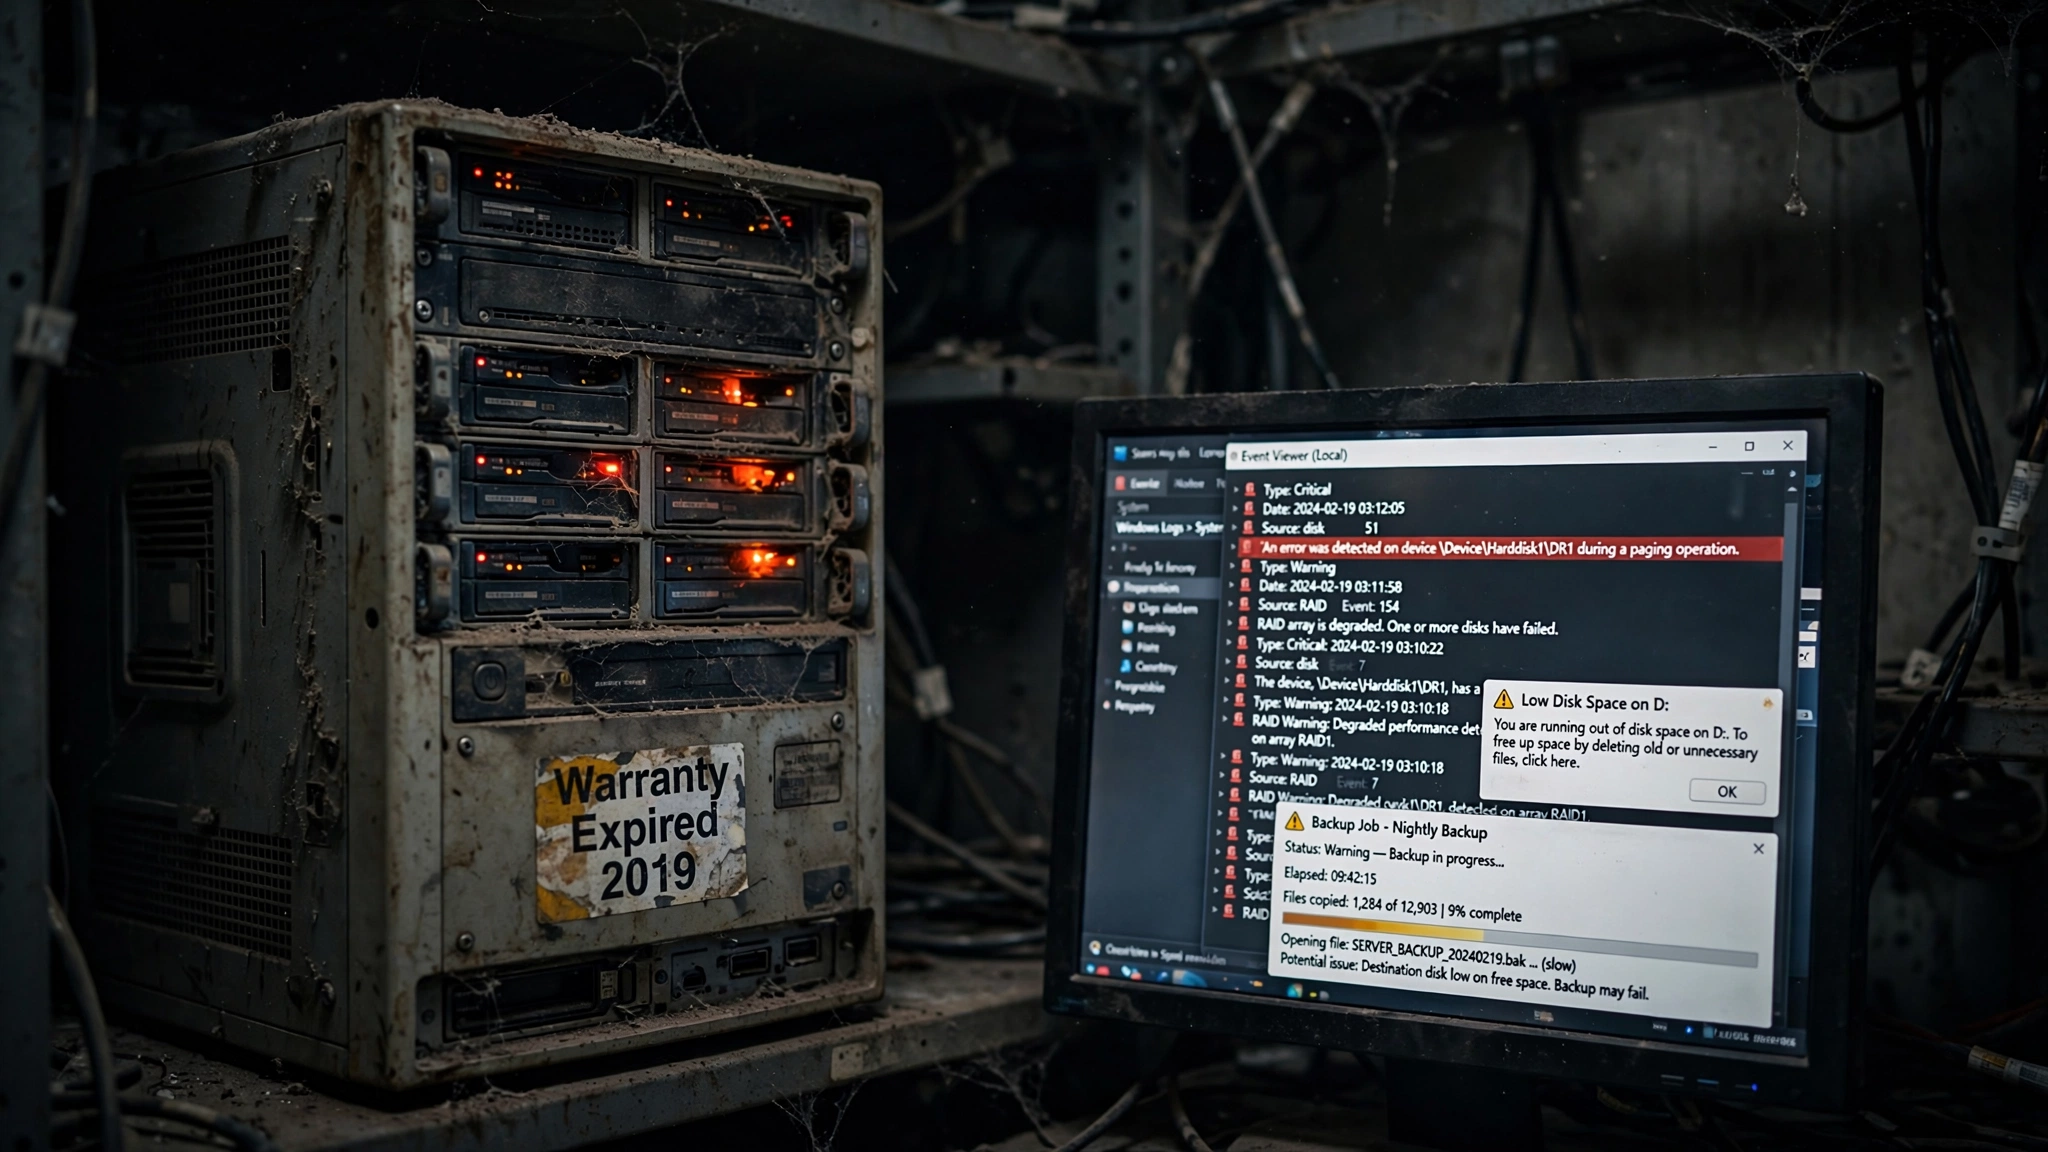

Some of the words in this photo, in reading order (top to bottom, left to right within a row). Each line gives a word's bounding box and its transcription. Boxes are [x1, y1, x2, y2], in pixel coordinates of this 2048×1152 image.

[1241, 450, 1270, 462] Event
[1273, 449, 1308, 461] Viewer
[1312, 449, 1348, 463] (Local)
[1264, 484, 1291, 499] Type:
[1294, 482, 1332, 496] Critical
[1263, 502, 1291, 515] Date:
[1293, 502, 1356, 515] 2024-02-19
[1358, 502, 1405, 515] 03:12:05
[1116, 521, 1159, 534] Windows
[1161, 521, 1184, 537] Logs
[1262, 522, 1301, 534] Source:
[1303, 521, 1325, 534] disk
[1365, 522, 1378, 534] 51
[1279, 544, 1306, 554] error
[1309, 544, 1329, 554] was
[1332, 541, 1382, 554] detected
[1384, 544, 1398, 554] on
[1401, 541, 1436, 554] device
[1577, 542, 1616, 558] during
[1620, 546, 1628, 555] a
[1630, 543, 1672, 559] paging
[1676, 544, 1739, 558] operation.
[1260, 561, 1288, 576] Type:
[1290, 561, 1336, 577] Warning
[1259, 579, 1287, 592] Date:
[1290, 579, 1352, 593] 2024-02-19
[1354, 581, 1402, 594] 03:11:58
[1258, 598, 1297, 611] Source:
[1299, 599, 1327, 612] RAID
[1379, 600, 1400, 613] 154
[1257, 618, 1285, 630] RAID
[1287, 621, 1315, 635] array
[1317, 619, 1326, 631] is
[1329, 618, 1384, 635] degraded.
[1387, 620, 1411, 633] One
[1414, 624, 1426, 633] or
[1429, 625, 1459, 634] more
[1462, 620, 1489, 635] disks
[1492, 620, 1521, 635] have
[1523, 621, 1558, 636] failed.
[1257, 638, 1284, 652] Type:
[1330, 640, 1393, 653] 2024-02-19
[1396, 642, 1444, 655] 03:10:22
[1255, 656, 1294, 669] Source:
[1296, 657, 1319, 670] disk
[1255, 675, 1275, 688] The
[1277, 676, 1314, 691] device,
[1452, 681, 1471, 694] has
[1474, 685, 1480, 695] a
[1254, 696, 1281, 710] Type:
[1335, 699, 1398, 713] 2024-02-19
[1401, 700, 1449, 715] 03:10:18
[1521, 693, 1549, 708] Low
[1553, 694, 1582, 709] Disk
[1585, 696, 1627, 713] Space
[1631, 700, 1649, 711] on
[1654, 698, 1669, 712] D:
[1252, 715, 1280, 727] RAID
[1282, 715, 1331, 733] Warning:
[1333, 717, 1386, 733] Degraded
[1388, 721, 1459, 735] performance
[1494, 718, 1515, 731] You
[1519, 723, 1537, 731] are
[1540, 721, 1585, 737] running
[1589, 723, 1609, 734] out
[1612, 721, 1626, 734] of
[1628, 722, 1652, 736] disk
[1655, 727, 1690, 742] space
[1693, 728, 1709, 738] on
[1713, 727, 1729, 739] D:.
[1733, 728, 1748, 741] To
[1251, 736, 1266, 745] on
[1268, 736, 1296, 749] array
[1298, 735, 1335, 747] RAID1.
[1493, 735, 1516, 749] free
[1519, 739, 1534, 752] up
[1537, 740, 1571, 754] space
[1574, 739, 1589, 754] by
[1592, 739, 1640, 757] deleting
[1643, 741, 1663, 755] old
[1666, 746, 1680, 756] or
[1683, 747, 1758, 763] unnecessary
[1251, 752, 1279, 766] Type:
[1281, 754, 1328, 770] Warning:
[1331, 756, 1394, 770] 2024-02-19
[1396, 759, 1444, 774] 03:10:18
[1493, 752, 1518, 767] files,
[1522, 753, 1548, 767] click
[1551, 755, 1580, 768] here.
[553, 757, 729, 806] Warranty
[1249, 772, 1287, 785] Source:
[1290, 774, 1317, 786] RAID
[1372, 778, 1378, 790] 7
[1248, 790, 1275, 803] RAID
[1718, 786, 1737, 798] OK
[572, 802, 718, 857] Expired
[1312, 816, 1355, 835] Backup
[1358, 818, 1380, 833] Job
[1393, 821, 1438, 839] Nightly
[1441, 823, 1488, 842] Backup
[1285, 840, 1321, 855] Status:
[1324, 844, 1370, 861] Warning
[1389, 848, 1429, 865] Backup
[1432, 850, 1443, 863] in
[1447, 854, 1505, 870] progress...
[601, 852, 696, 900] 2019
[1284, 867, 1328, 882] Elapsed:
[1331, 869, 1377, 885] 09:42:15
[1243, 906, 1269, 920] RAID
[1284, 891, 1307, 904] Files
[1309, 894, 1349, 909] copied:
[1353, 896, 1382, 911] 1,284
[1385, 898, 1398, 911] of
[1401, 900, 1437, 916] 12,903
[1448, 903, 1466, 917] 9%
[1470, 907, 1522, 924] complete
[1281, 932, 1327, 951] Opening
[1329, 934, 1350, 950] file:
[1352, 940, 1526, 969] SERVER_BACKUP_20240219.bak
[1542, 957, 1577, 974] (slow)
[1280, 952, 1327, 968] Potential
[1329, 956, 1359, 971] issue:
[1361, 960, 1422, 977] Destination
[1425, 966, 1448, 980] disk
[1450, 968, 1470, 983] low
[1473, 972, 1488, 983] on
[1491, 971, 1513, 986] free
[1515, 976, 1552, 992] space.
[1554, 978, 1596, 997] Backup
[1600, 985, 1624, 1000] may
[1627, 985, 1649, 1000] fail.
